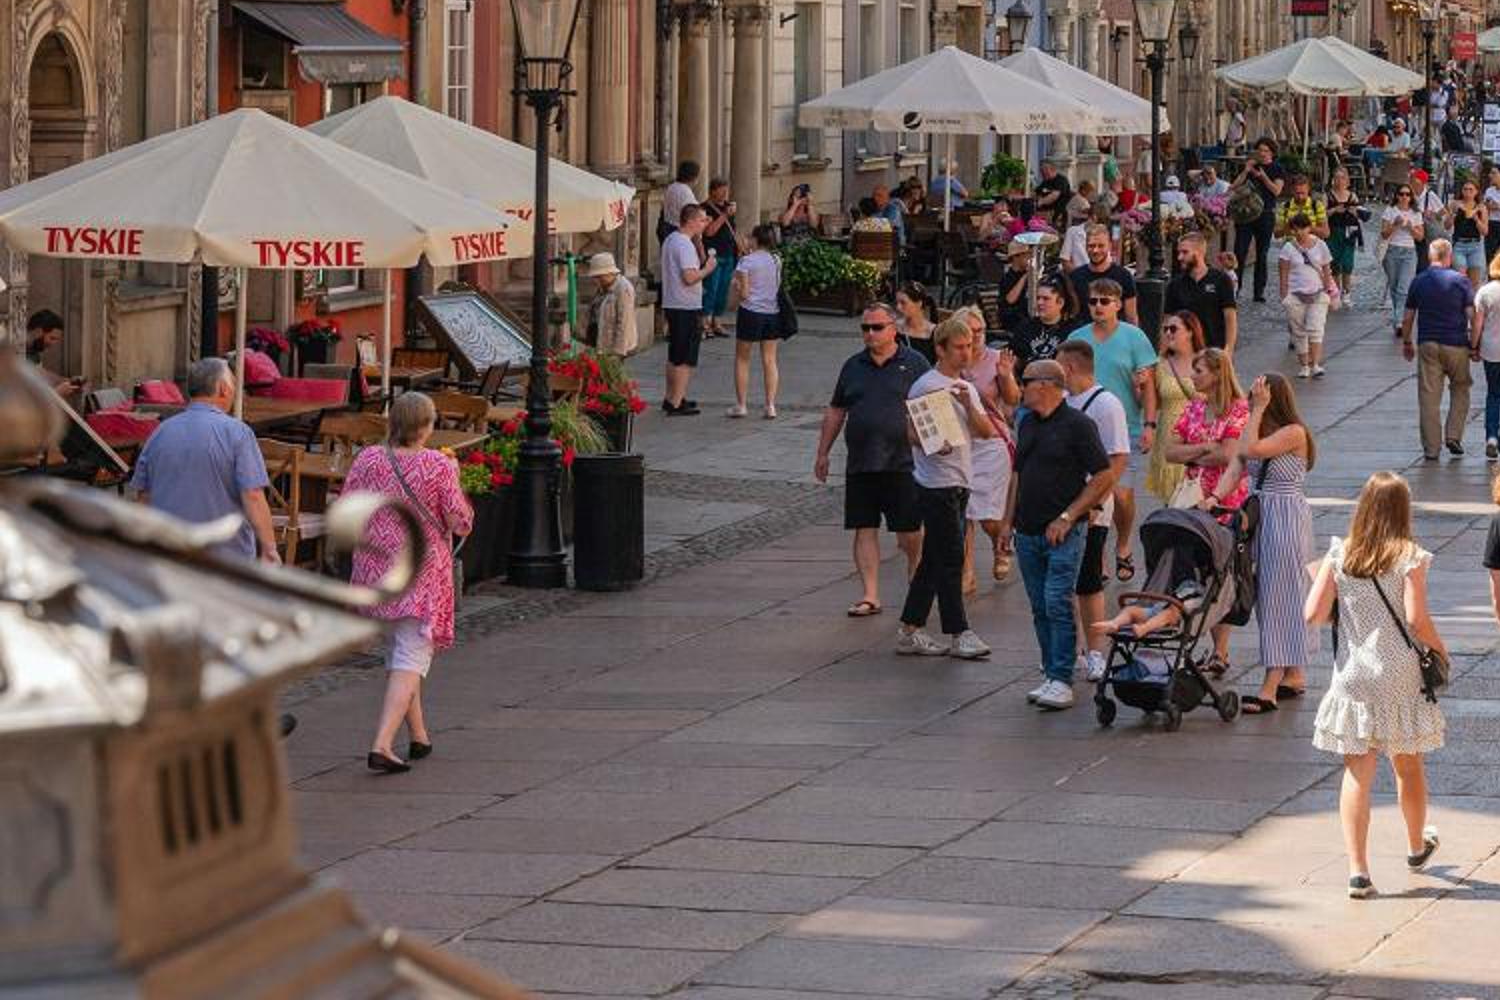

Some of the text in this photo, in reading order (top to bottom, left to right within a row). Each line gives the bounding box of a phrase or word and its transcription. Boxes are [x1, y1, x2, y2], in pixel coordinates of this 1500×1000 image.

[43, 227, 144, 255] TYSKIE
[251, 240, 364, 267] TYSKIE
[451, 231, 507, 262] TYSKIE
